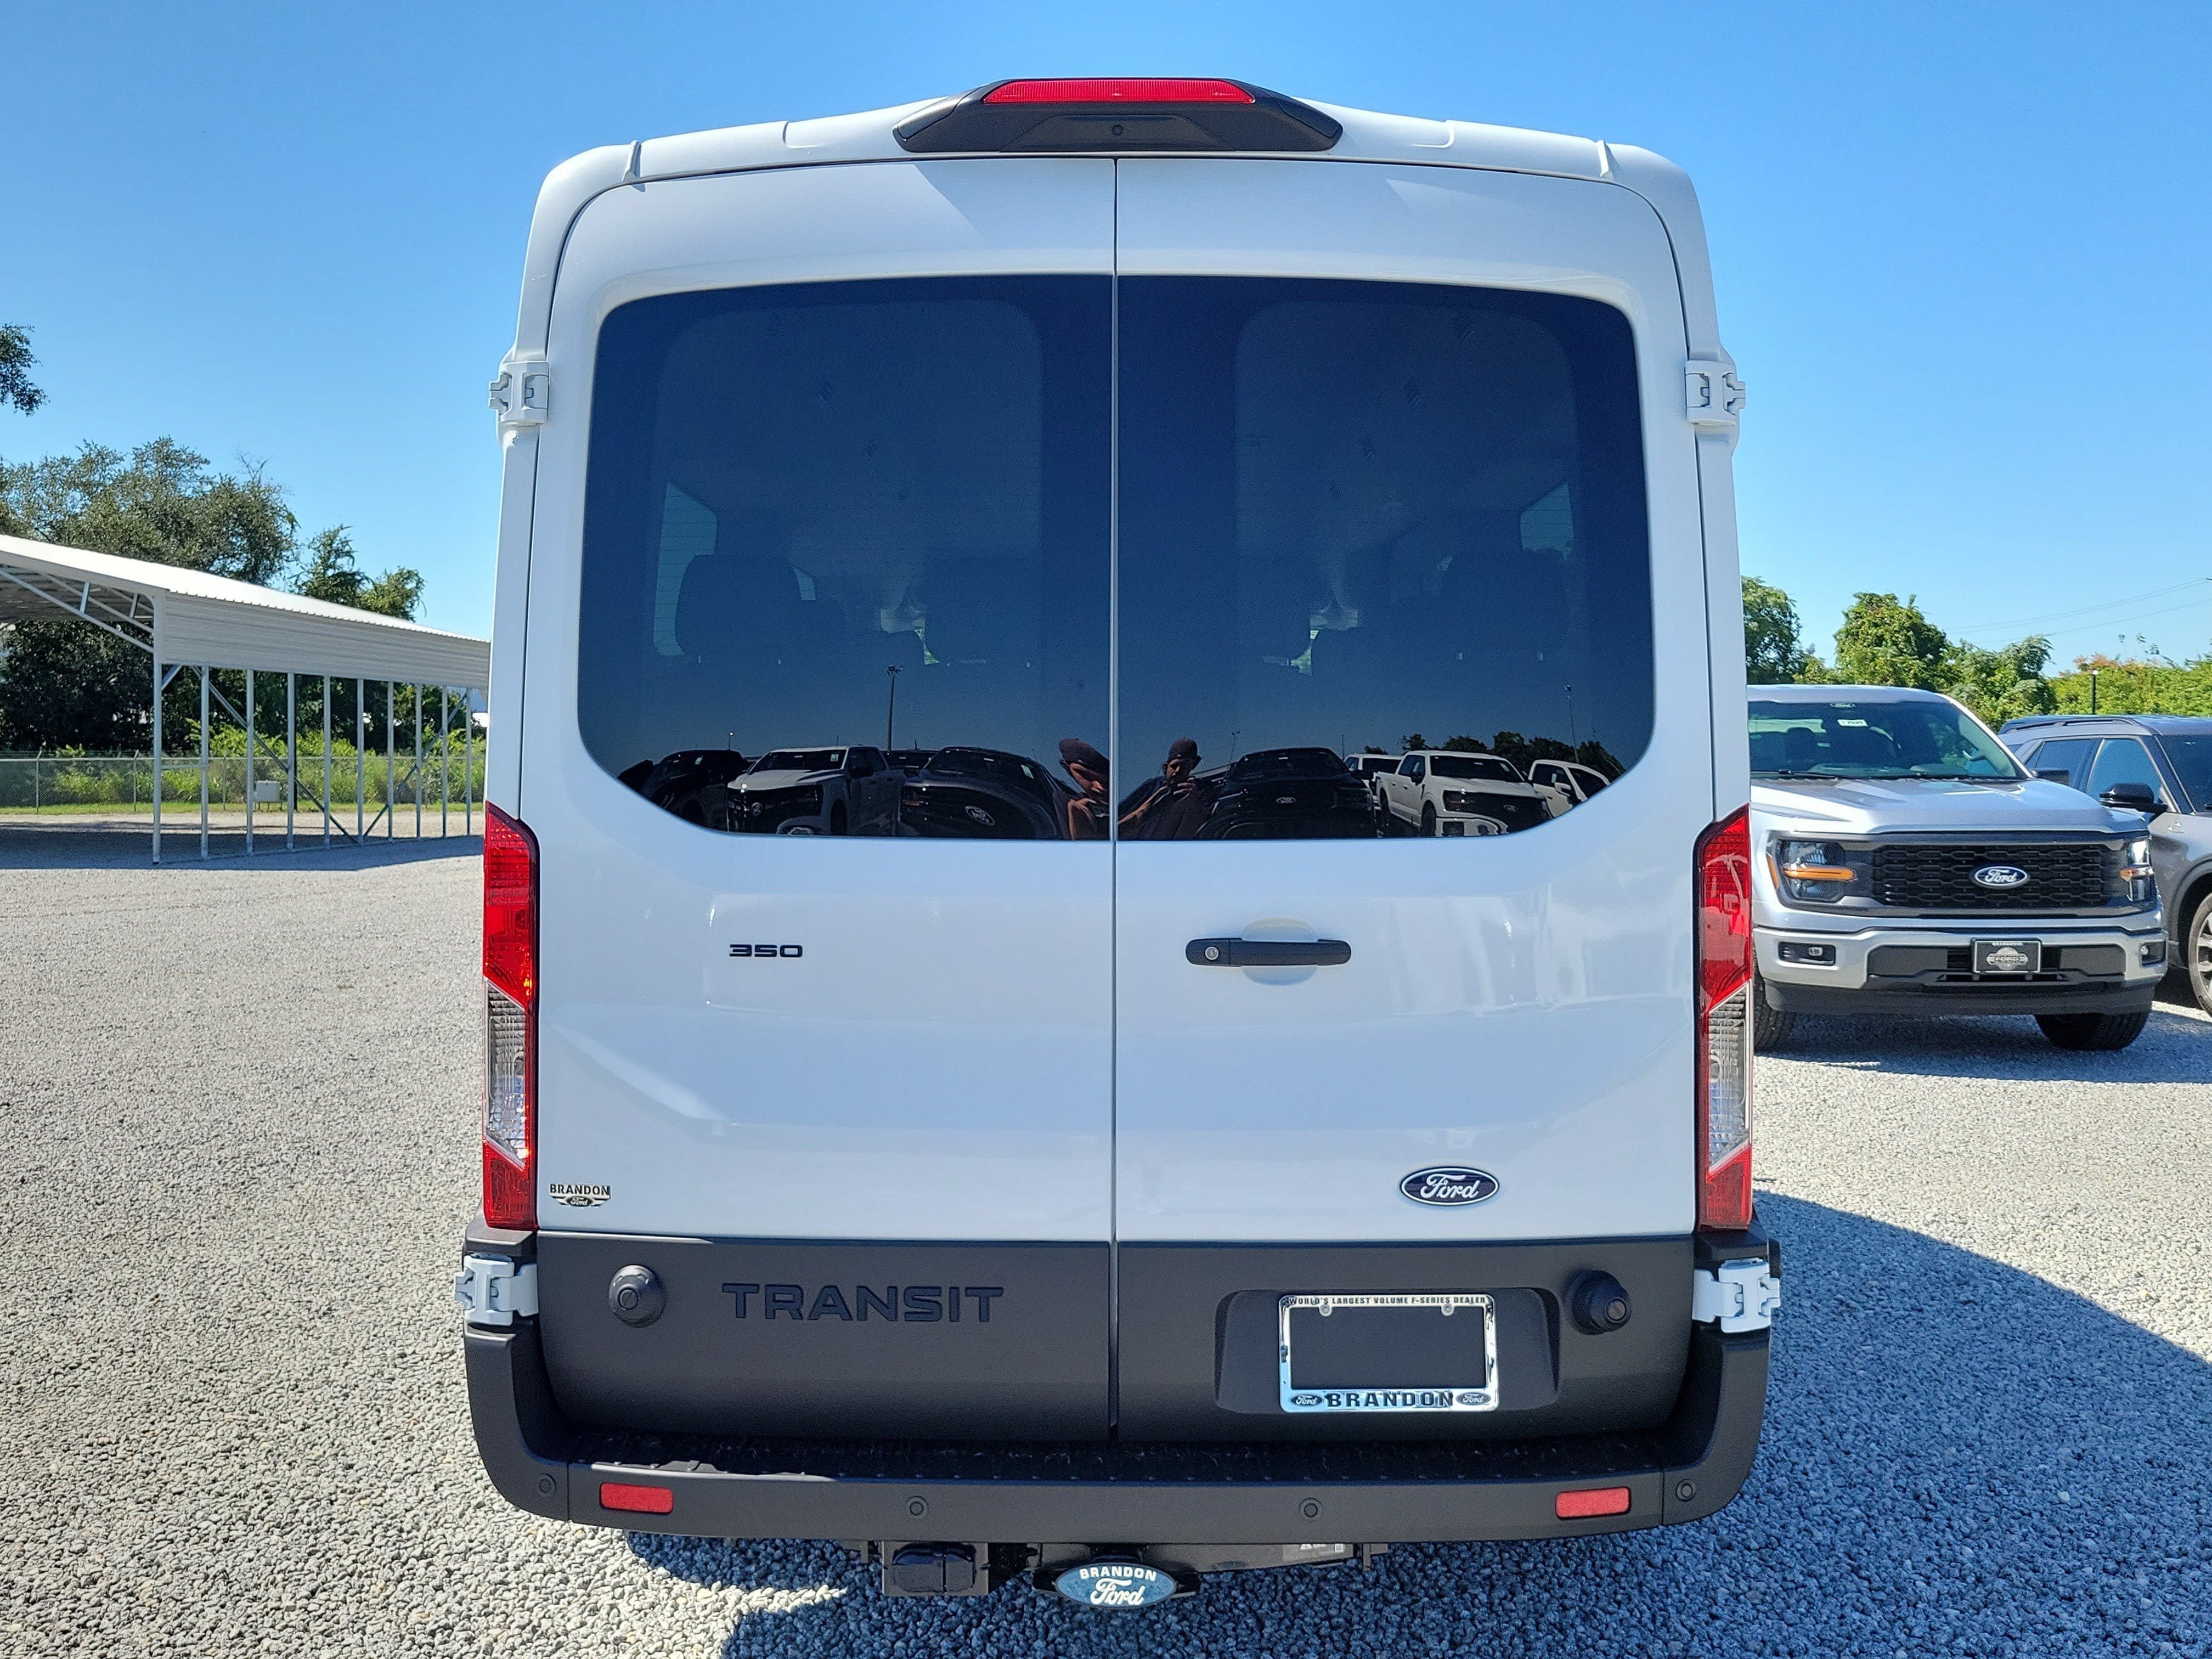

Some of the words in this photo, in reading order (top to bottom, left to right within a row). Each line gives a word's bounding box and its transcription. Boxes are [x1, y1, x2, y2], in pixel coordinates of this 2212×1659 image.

[1985, 868, 2018, 883] Ford
[729, 944, 803, 958] 350
[550, 1183, 611, 1195] BRANDON
[1420, 1173, 1481, 1199] Ford
[571, 1197, 589, 1205] Ford
[722, 1283, 1005, 1323] TRANSIT
[1295, 1393, 1317, 1405] Ford
[1326, 1391, 1454, 1407] BRANDON
[1462, 1393, 1484, 1403] Ford
[1079, 1566, 1157, 1581] BRANDON
[1090, 1578, 1146, 1605] Ford
